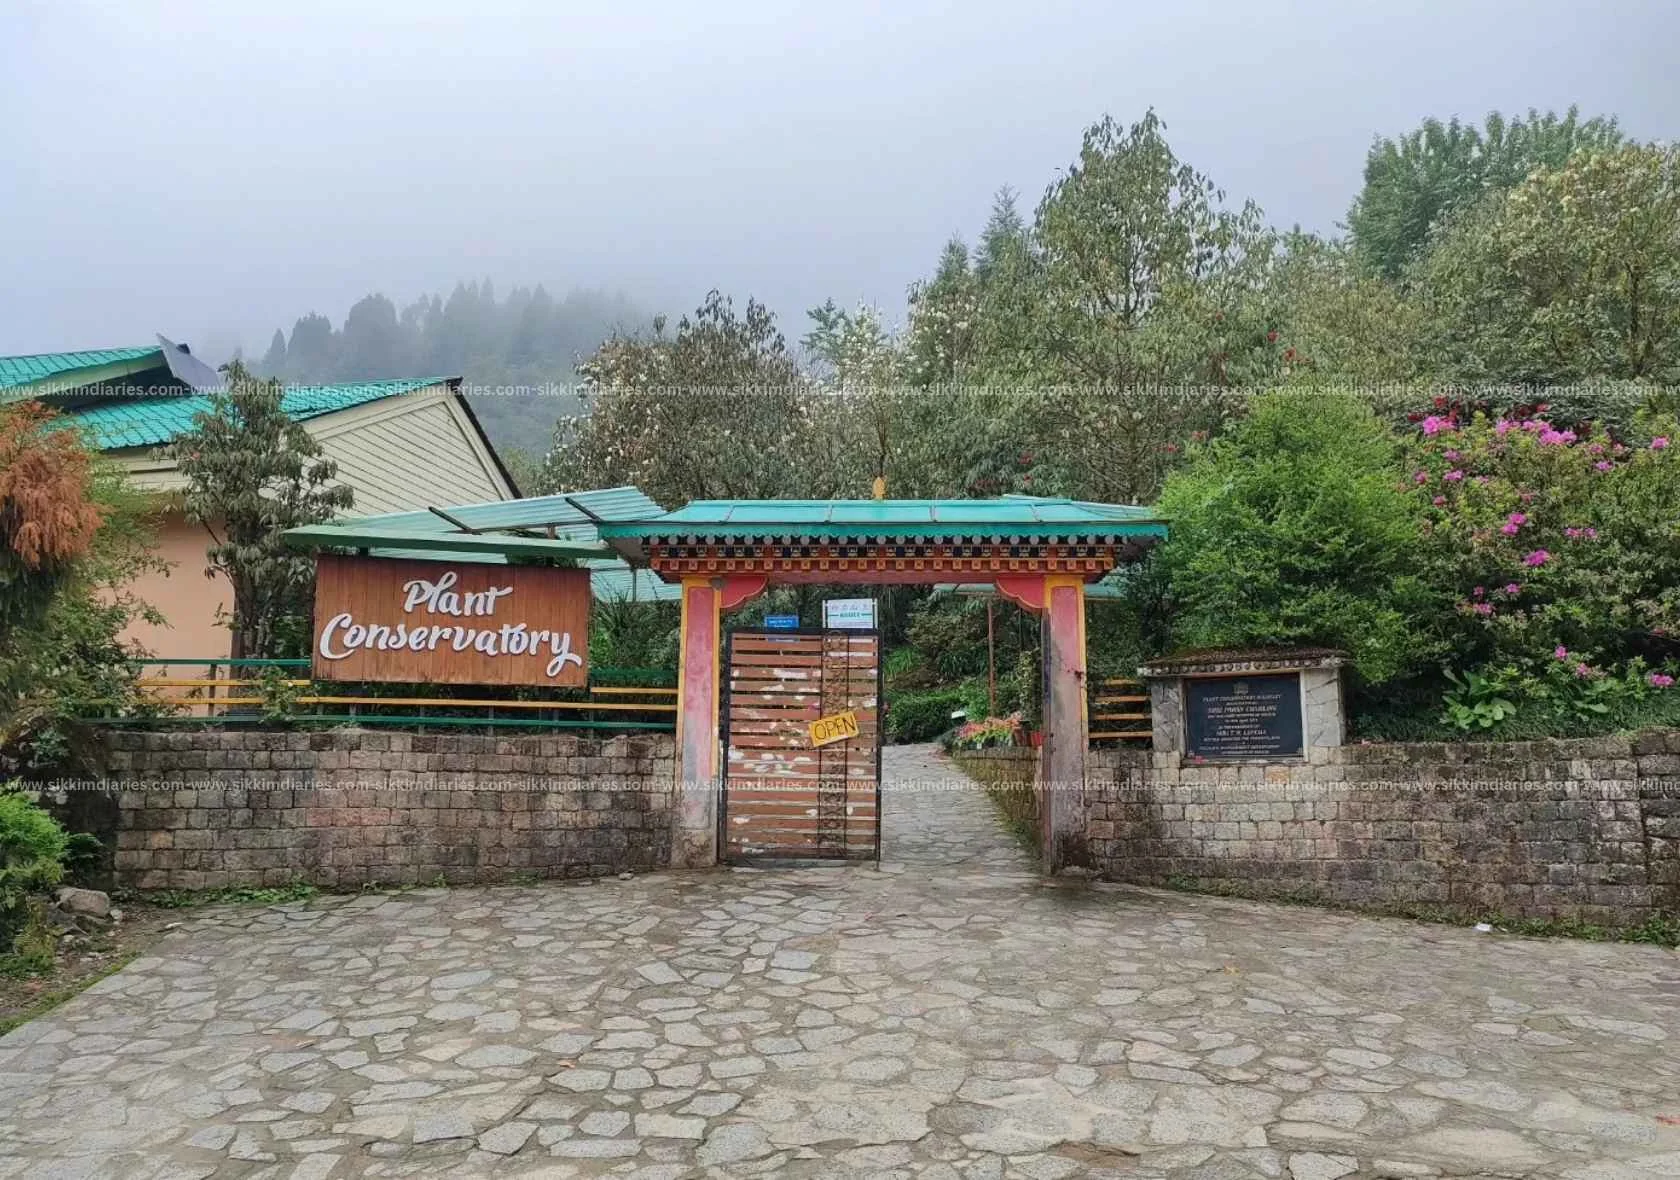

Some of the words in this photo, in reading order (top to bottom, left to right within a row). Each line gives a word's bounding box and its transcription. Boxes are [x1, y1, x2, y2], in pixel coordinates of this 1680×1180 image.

[403, 571, 513, 617] Plant
[320, 613, 582, 678] Conservatory
[814, 718, 856, 739] OPEN
